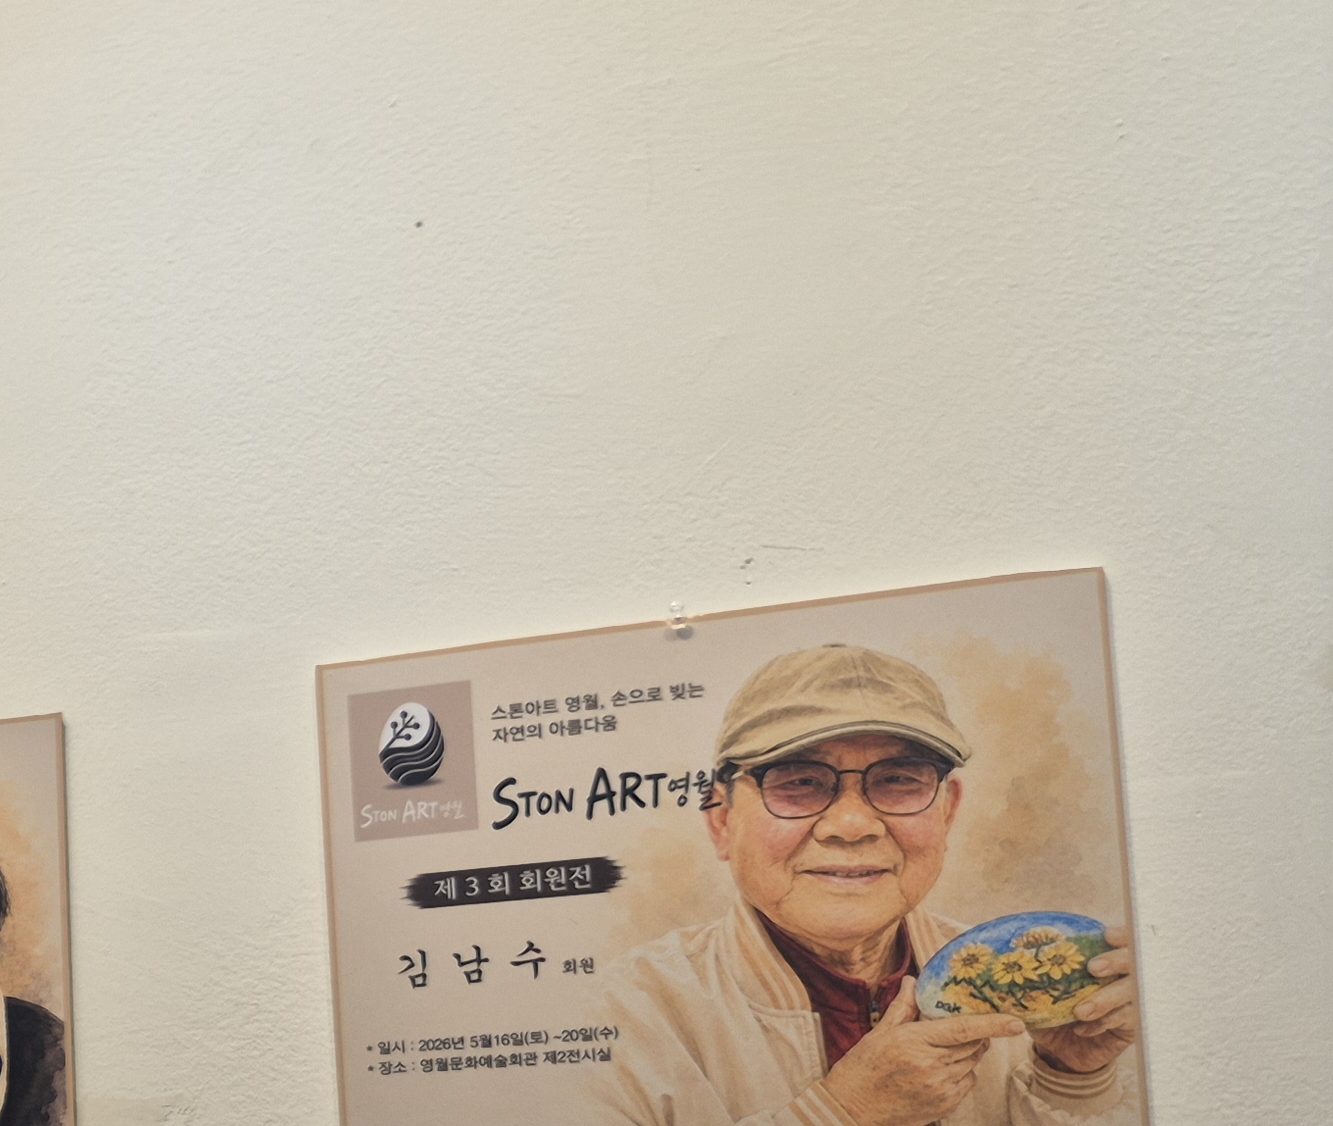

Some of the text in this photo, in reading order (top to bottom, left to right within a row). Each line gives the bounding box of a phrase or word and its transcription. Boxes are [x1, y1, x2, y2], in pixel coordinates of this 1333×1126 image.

[490, 698, 558, 721] 스톤아트
[565, 694, 605, 713] 영월,
[612, 687, 663, 706] 손으로
[492, 716, 617, 743] 자연의 아름다움
[361, 804, 397, 828] STON
[492, 777, 573, 830] STON
[519, 865, 592, 891] 회원전
[562, 958, 594, 974] 회원
[419, 1036, 464, 1052] 2026년
[470, 1031, 548, 1048] 5월16일(토)
[420, 1055, 537, 1072] 영월문화예술회관
[543, 1048, 611, 1064] 제2전시실
